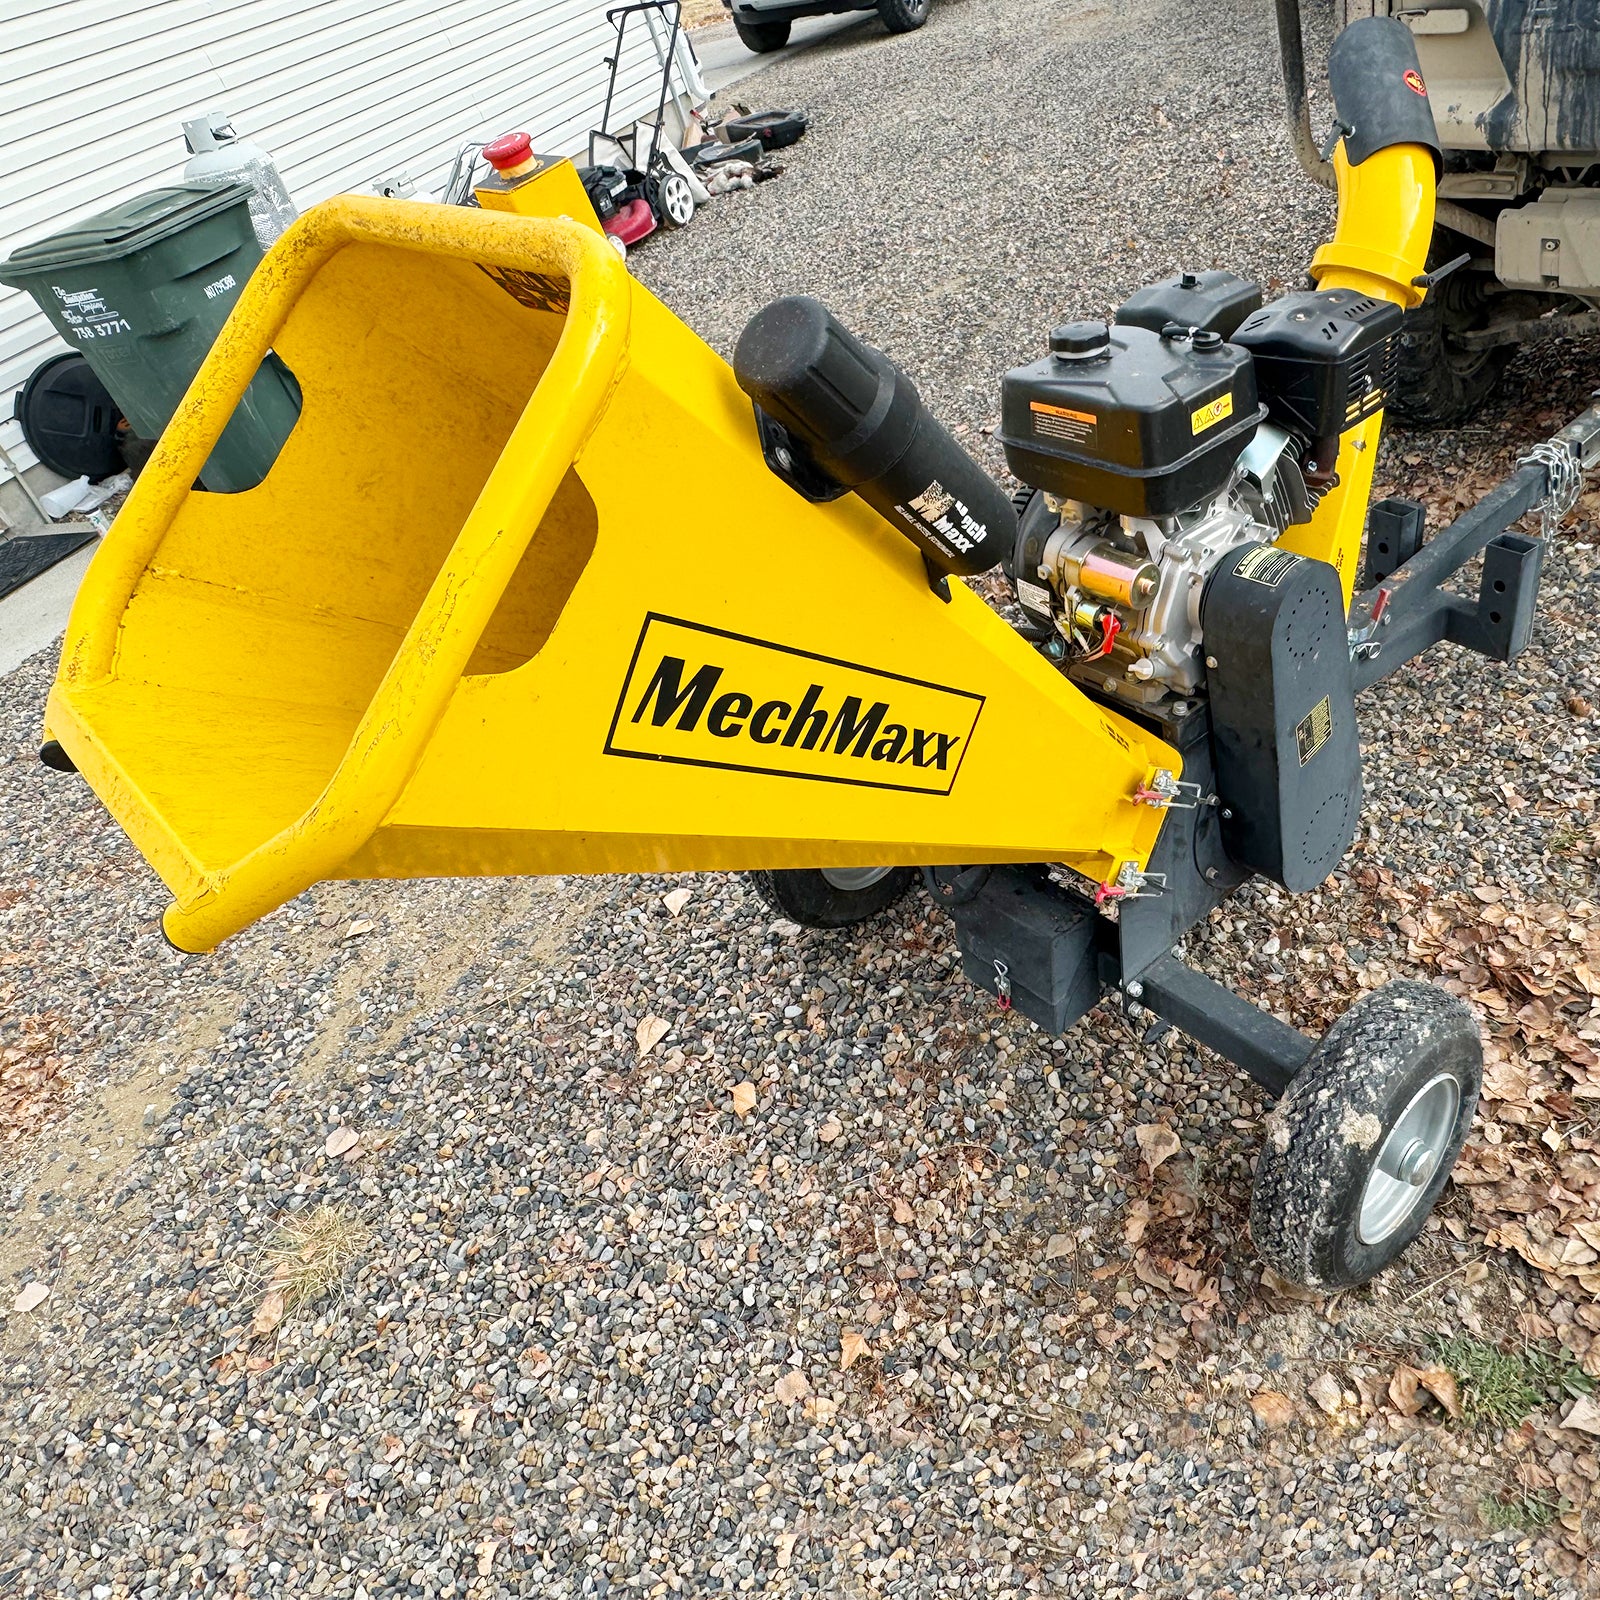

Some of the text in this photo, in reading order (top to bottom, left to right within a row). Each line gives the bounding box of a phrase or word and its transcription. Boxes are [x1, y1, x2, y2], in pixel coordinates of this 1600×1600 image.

[72, 319, 131, 339] 738 3771
[631, 655, 960, 770] MechMaxx
